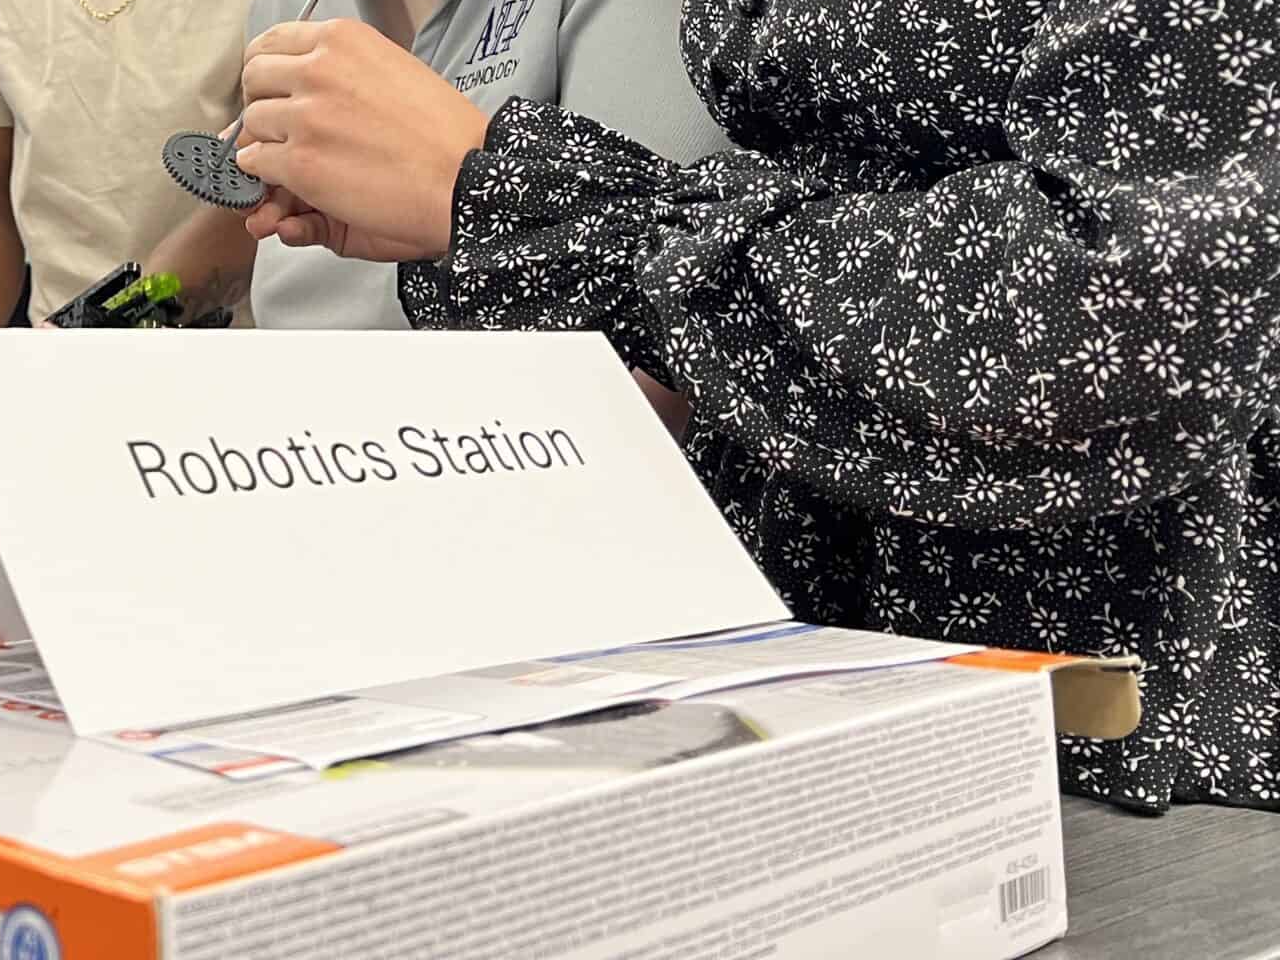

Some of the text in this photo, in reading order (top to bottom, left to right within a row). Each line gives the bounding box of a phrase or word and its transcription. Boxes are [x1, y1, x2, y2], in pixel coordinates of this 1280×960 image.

[456, 59, 521, 92] TECHNOLOGY
[128, 420, 586, 499] Robotics Station
